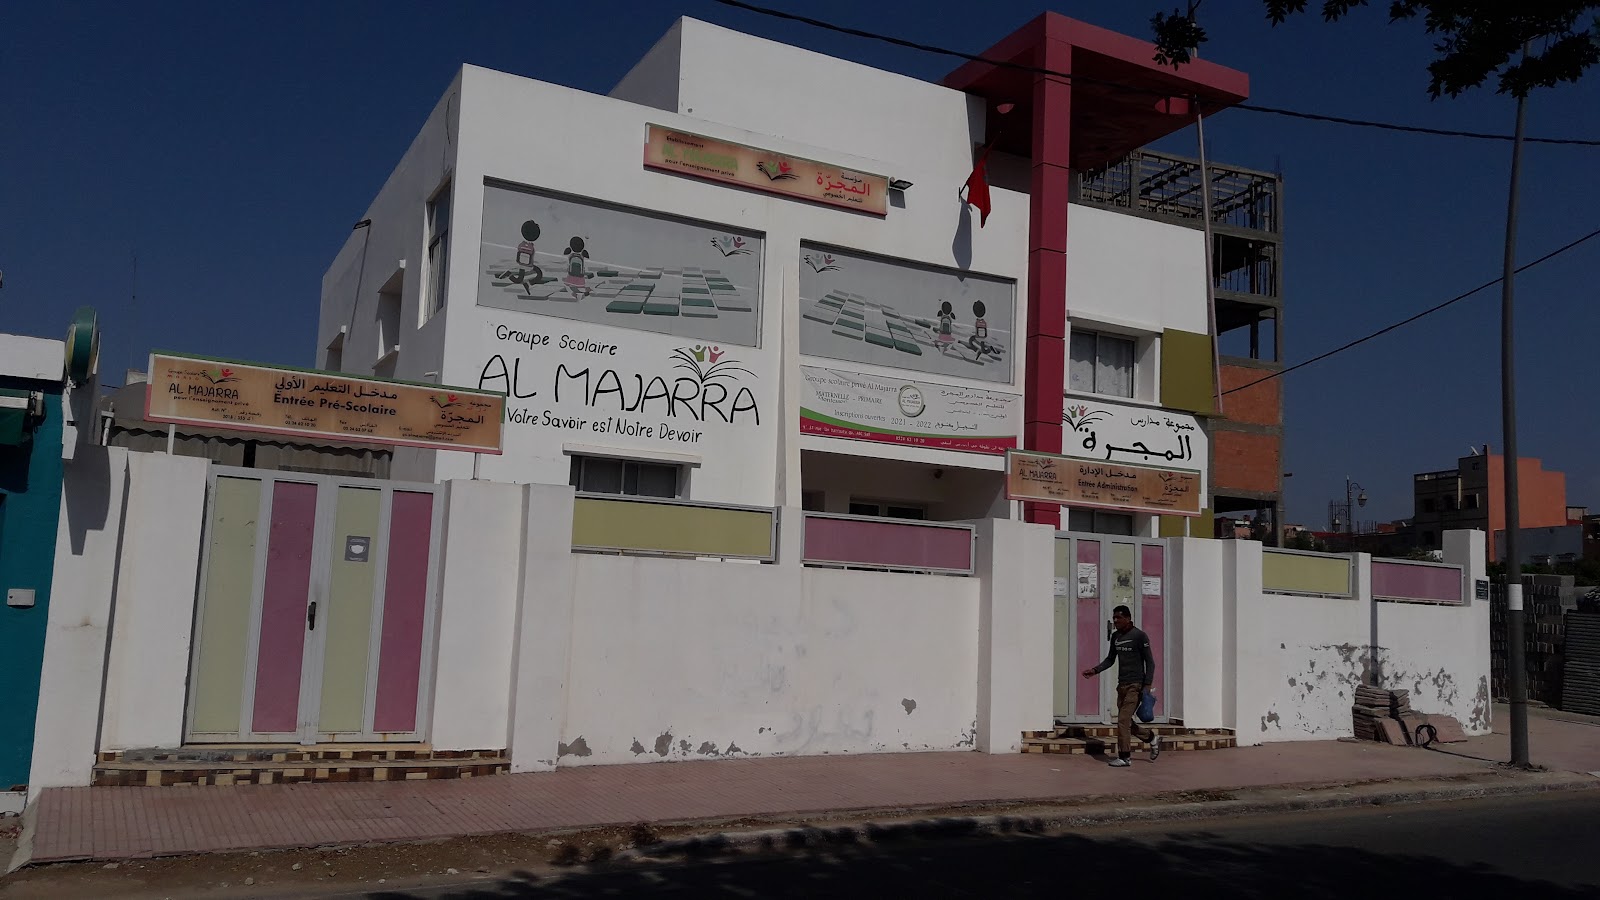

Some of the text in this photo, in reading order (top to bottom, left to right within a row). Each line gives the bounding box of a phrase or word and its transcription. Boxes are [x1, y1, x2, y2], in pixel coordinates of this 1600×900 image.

[841, 172, 862, 183] مؤسسة
[496, 324, 618, 356] Groupe Scolaire
[805, 375, 826, 384] Groupe
[828, 377, 850, 387] scolaire
[169, 382, 238, 399] AL MAJARRA
[309, 383, 350, 394] التعليم
[354, 386, 398, 399] مدخل
[479, 354, 760, 426] AL MAJARRA
[274, 393, 396, 415] Entrée Pré-Scolaire
[816, 390, 849, 400] MATERNELLE
[858, 396, 882, 404] PRIMAIRE
[834, 409, 886, 421] Inscriptions ouvertes
[507, 406, 702, 443] Votre Savoir est Notre Devoir
[891, 418, 906, 426] 2021
[916, 420, 931, 429] 2022
[1131, 415, 1194, 433] مجموعة مدارس
[1082, 427, 1192, 461] المجرة
[1030, 470, 1056, 480] MAJARRA
[1079, 465, 1137, 479] مدخل الإدارة
[1078, 479, 1096, 488] Entrée
[1097, 482, 1138, 492] Administration
